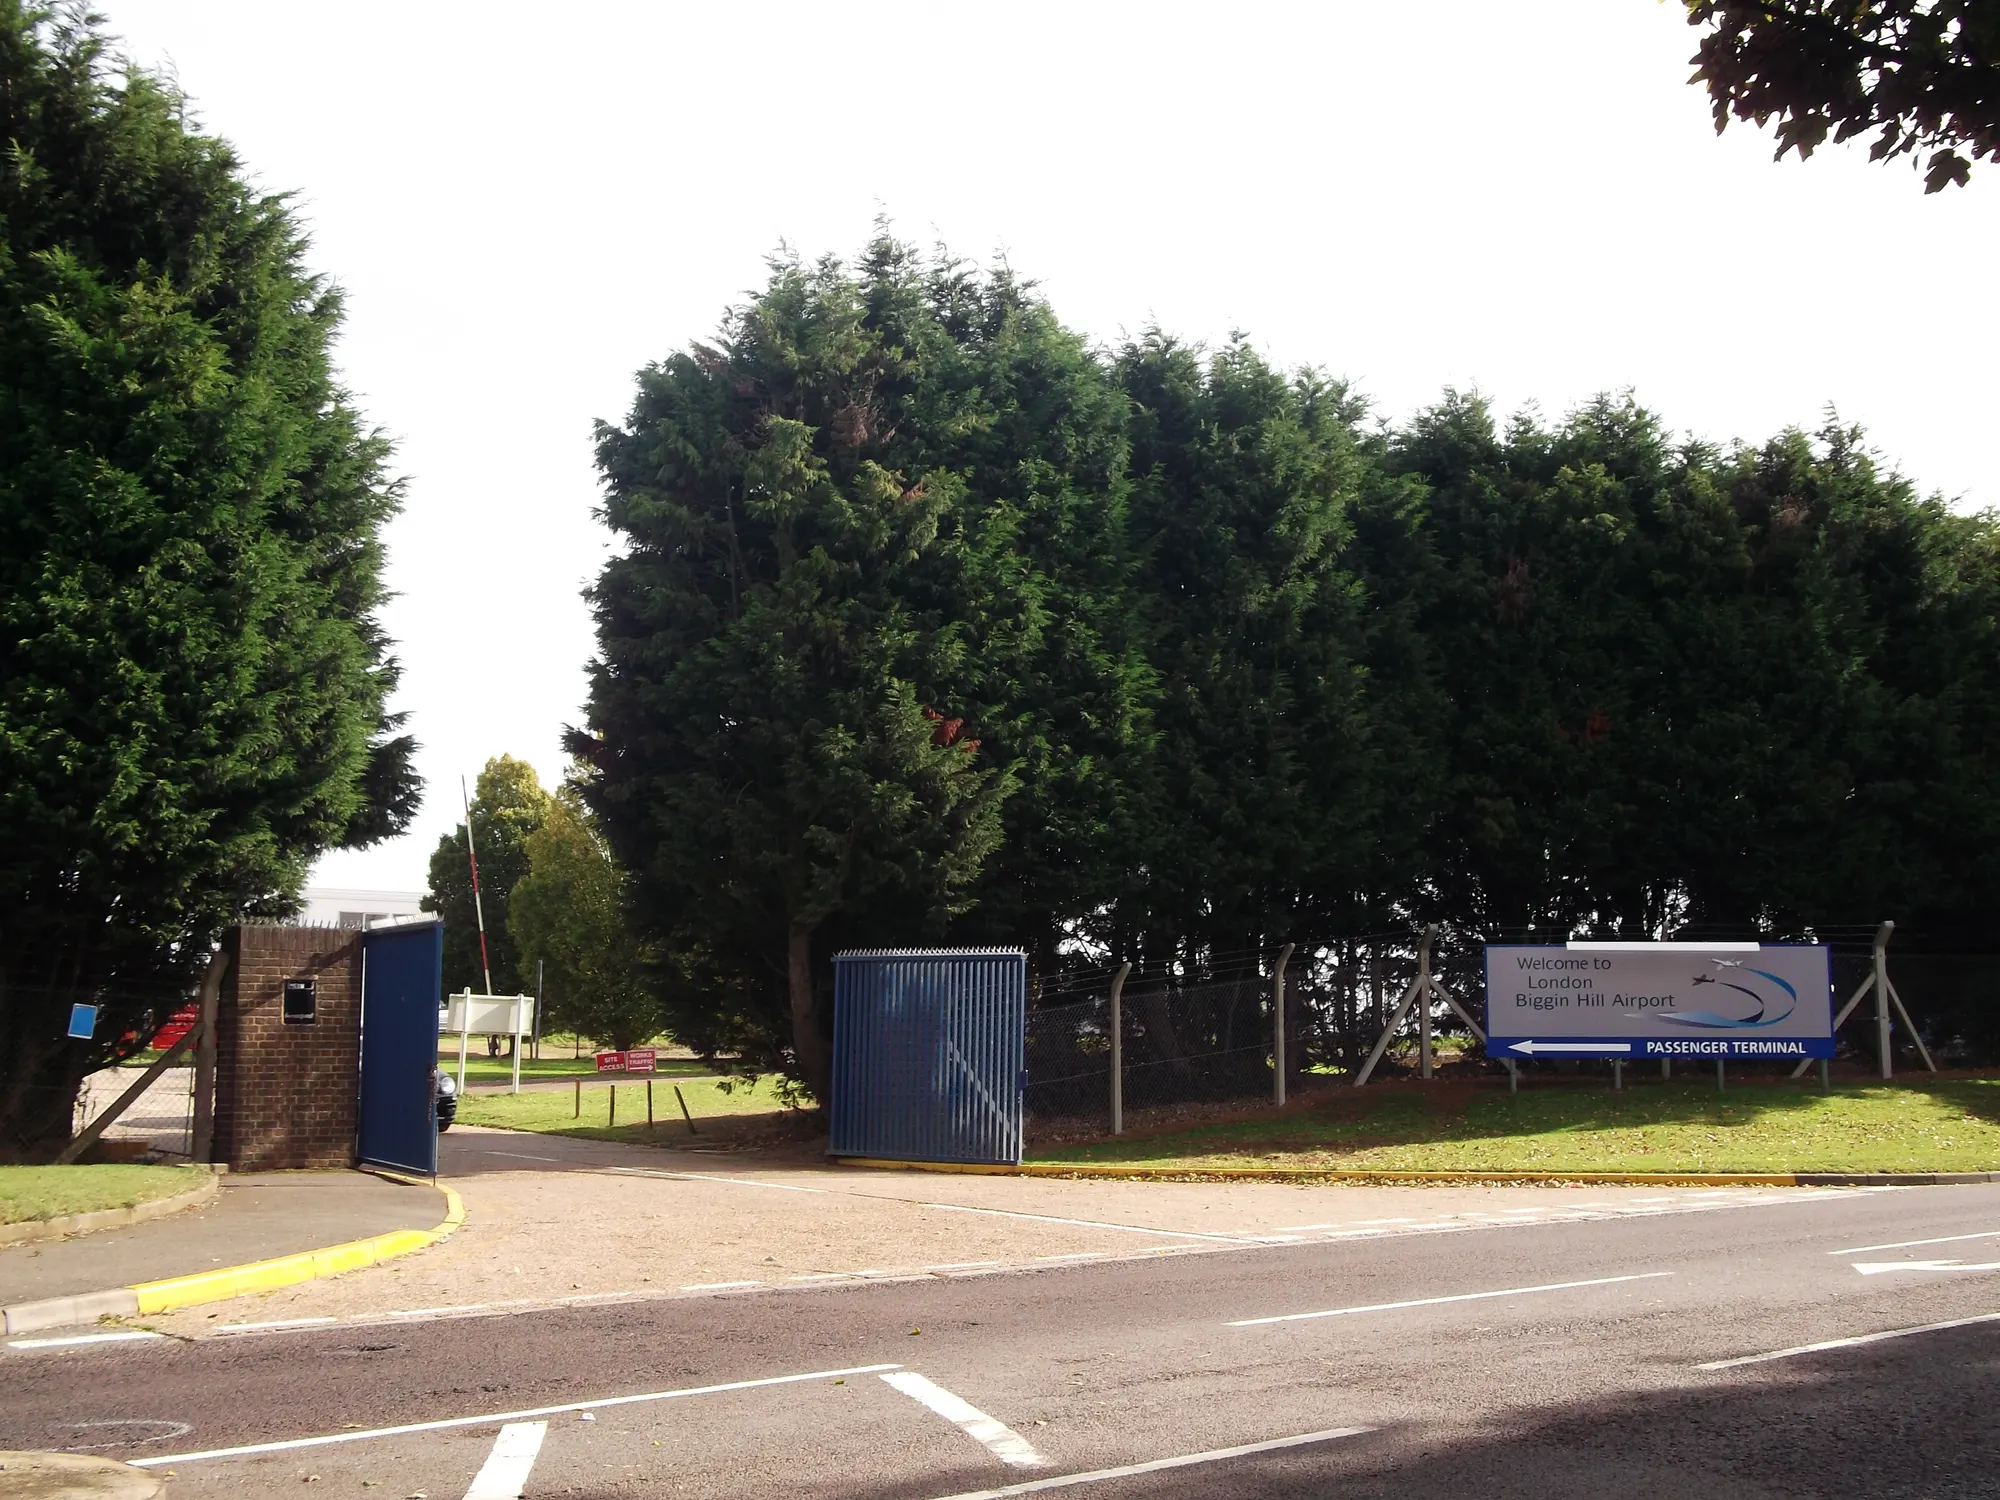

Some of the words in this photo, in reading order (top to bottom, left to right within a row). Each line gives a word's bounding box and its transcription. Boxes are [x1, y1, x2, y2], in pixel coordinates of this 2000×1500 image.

[1517, 957, 1589, 970] Welcome
[1594, 959, 1612, 970] to
[1528, 976, 1593, 989] London
[1516, 994, 1569, 1010] Biggin
[1577, 994, 1605, 1007] Hill
[1612, 994, 1676, 1010] Airport
[1646, 1042, 1729, 1054] PASSENGER
[1732, 1042, 1807, 1054] TERMINAL
[599, 1063, 625, 1071] ACCESS
